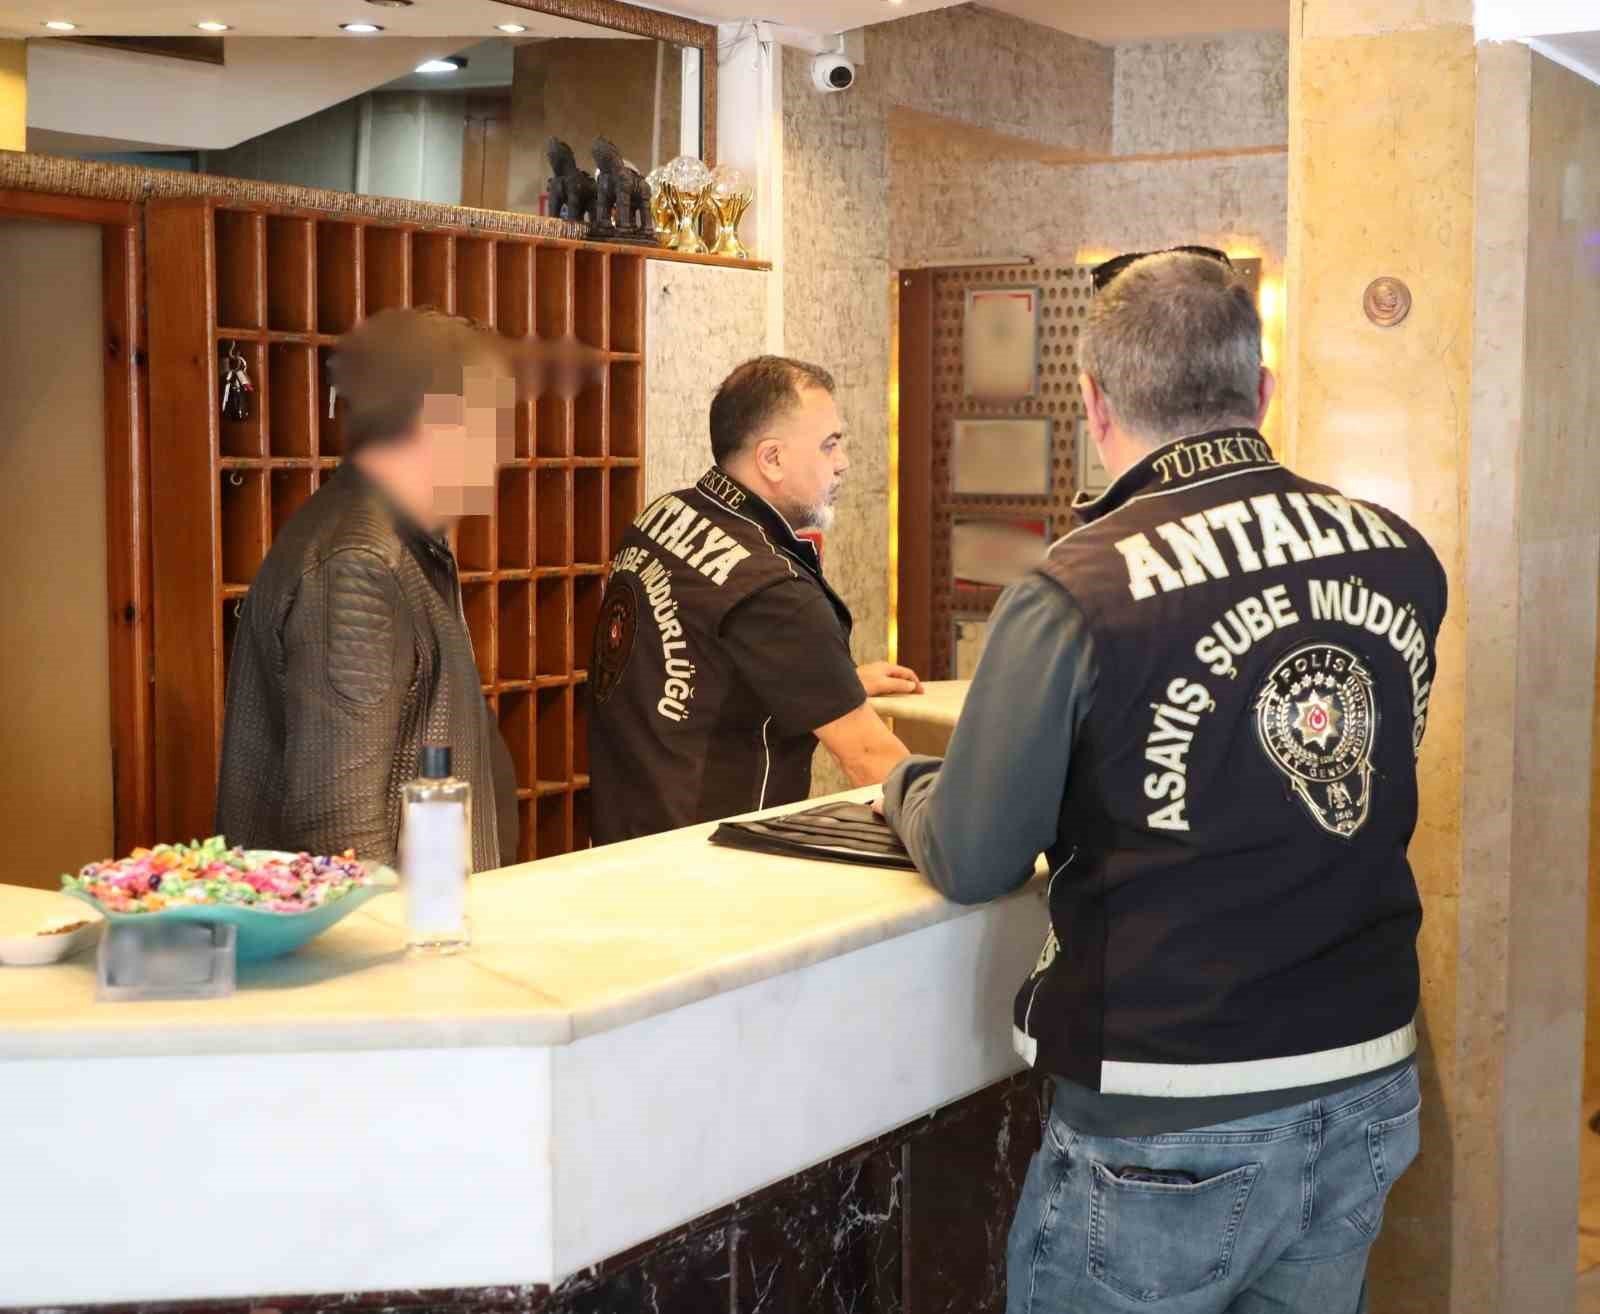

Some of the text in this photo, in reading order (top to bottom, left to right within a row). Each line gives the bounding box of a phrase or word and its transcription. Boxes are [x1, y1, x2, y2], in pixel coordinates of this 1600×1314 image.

[632, 495, 752, 587] NTALYA
[1114, 492, 1407, 600] ANTALYA
[612, 546, 696, 723] UBE MÜDÜRLÜĞÜ
[1279, 650, 1347, 684] POLİS
[1144, 678, 1217, 831] ASAYİŞ
[1195, 584, 1300, 680] ŞUBE
